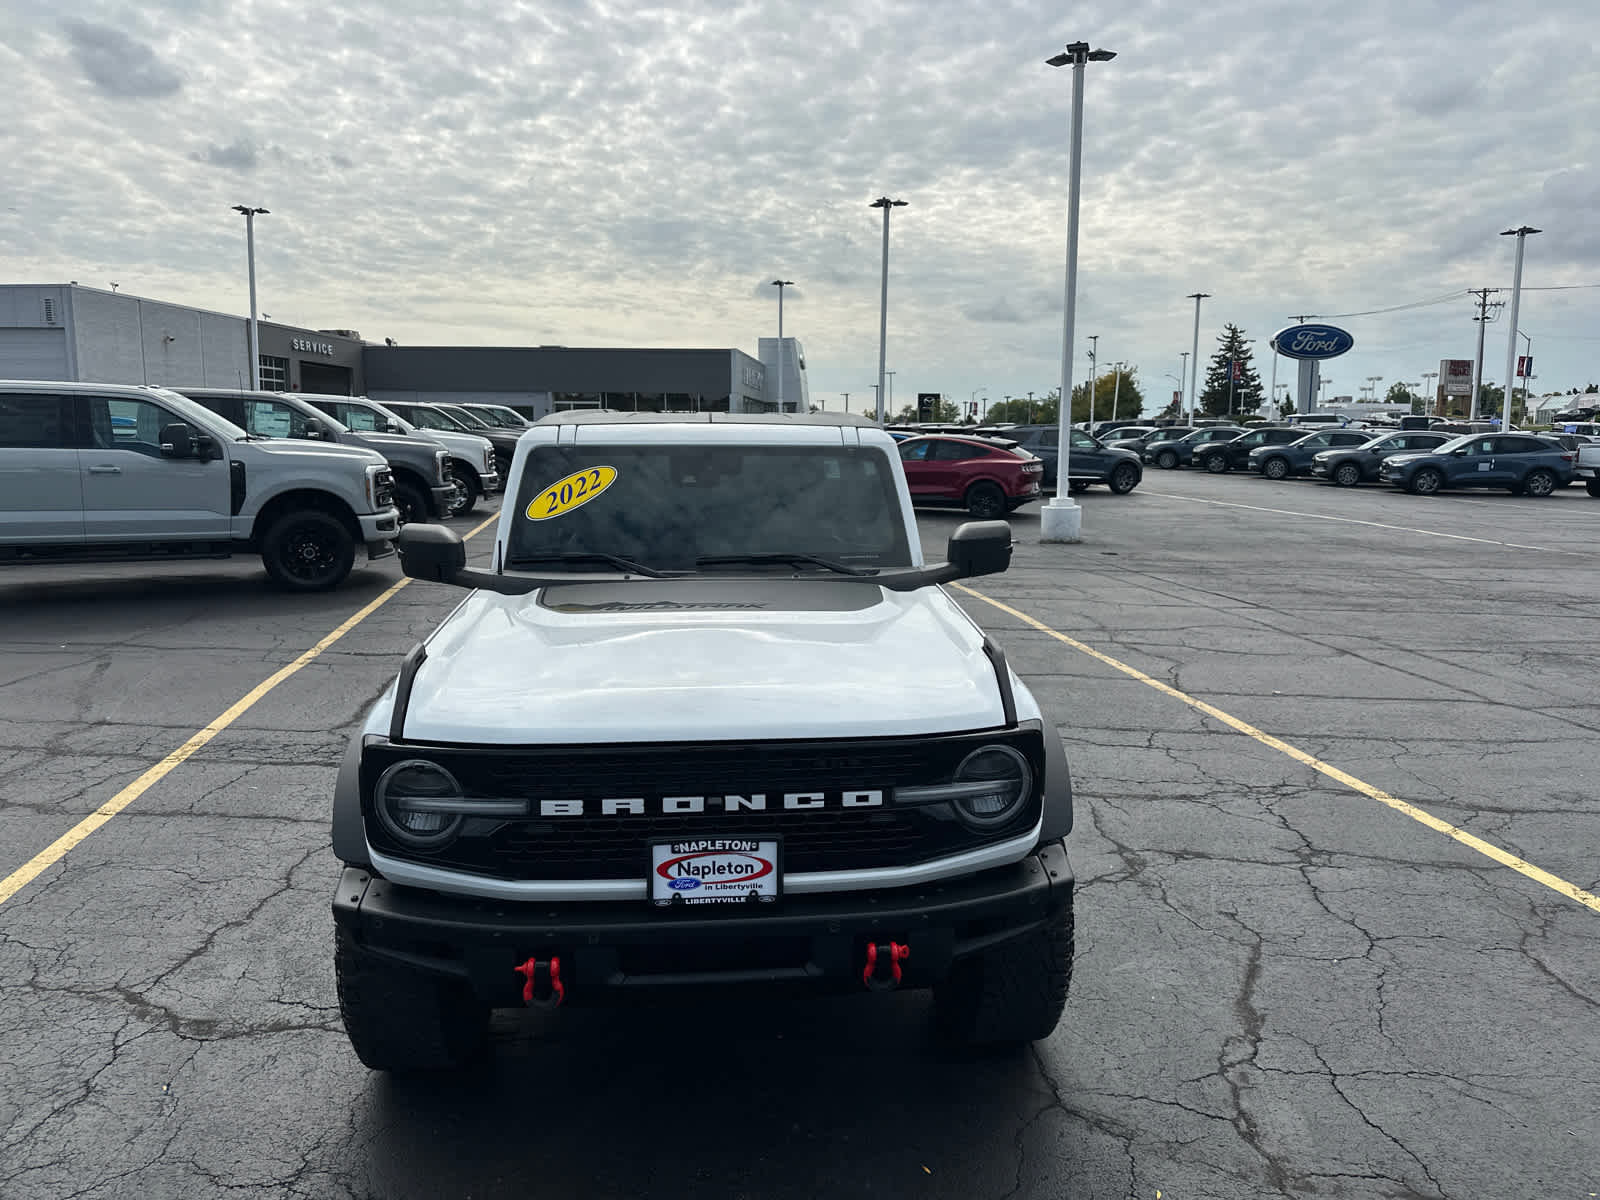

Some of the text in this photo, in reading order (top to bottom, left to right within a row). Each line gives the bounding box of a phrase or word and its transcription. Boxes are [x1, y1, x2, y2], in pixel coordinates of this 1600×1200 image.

[292, 338, 334, 355] SERVICE
[1292, 330, 1339, 351] Ford
[546, 469, 602, 514] 2022
[540, 790, 883, 816] BRONCO
[679, 840, 752, 853] NAPLETON
[677, 861, 755, 879] Napleton
[674, 879, 696, 889] Ford
[715, 883, 763, 892] Libertyville
[685, 897, 747, 905] LIBERTYVILLE
